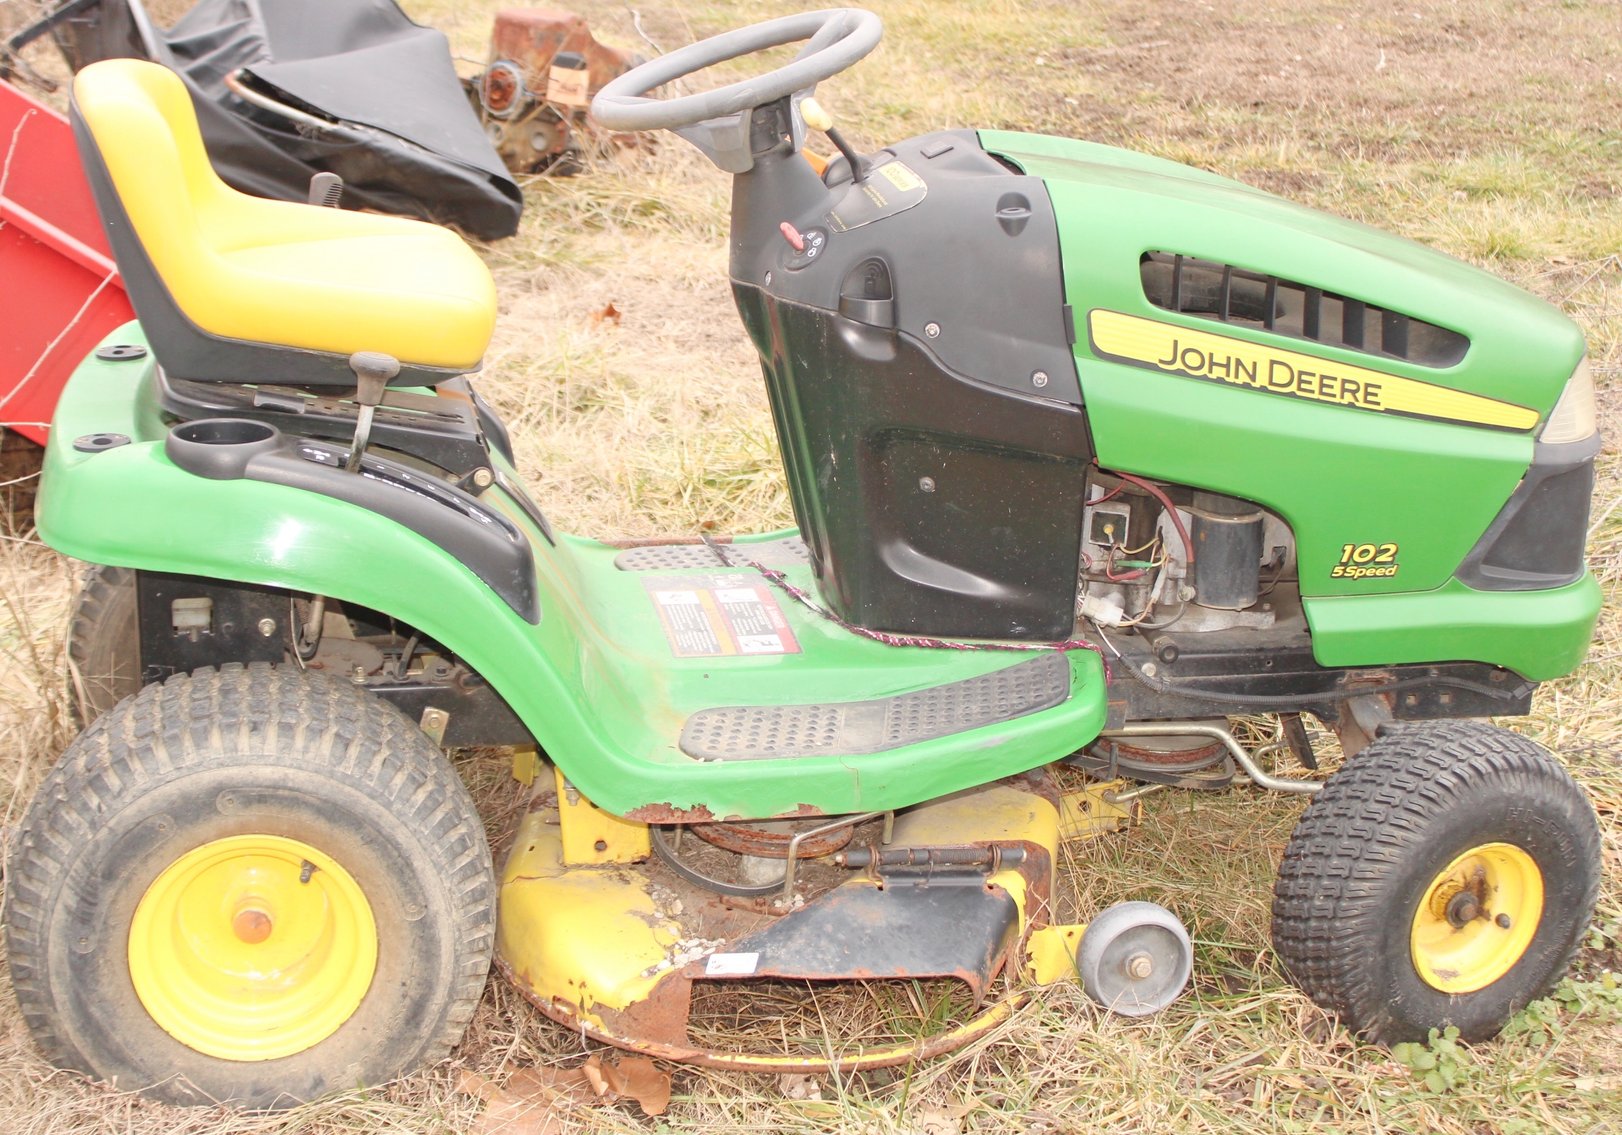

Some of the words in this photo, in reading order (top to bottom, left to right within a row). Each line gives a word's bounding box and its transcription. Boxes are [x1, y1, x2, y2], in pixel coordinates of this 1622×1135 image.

[1157, 339, 1257, 383] JOHN
[1268, 359, 1382, 406] DEERE
[1340, 543, 1398, 565] 102
